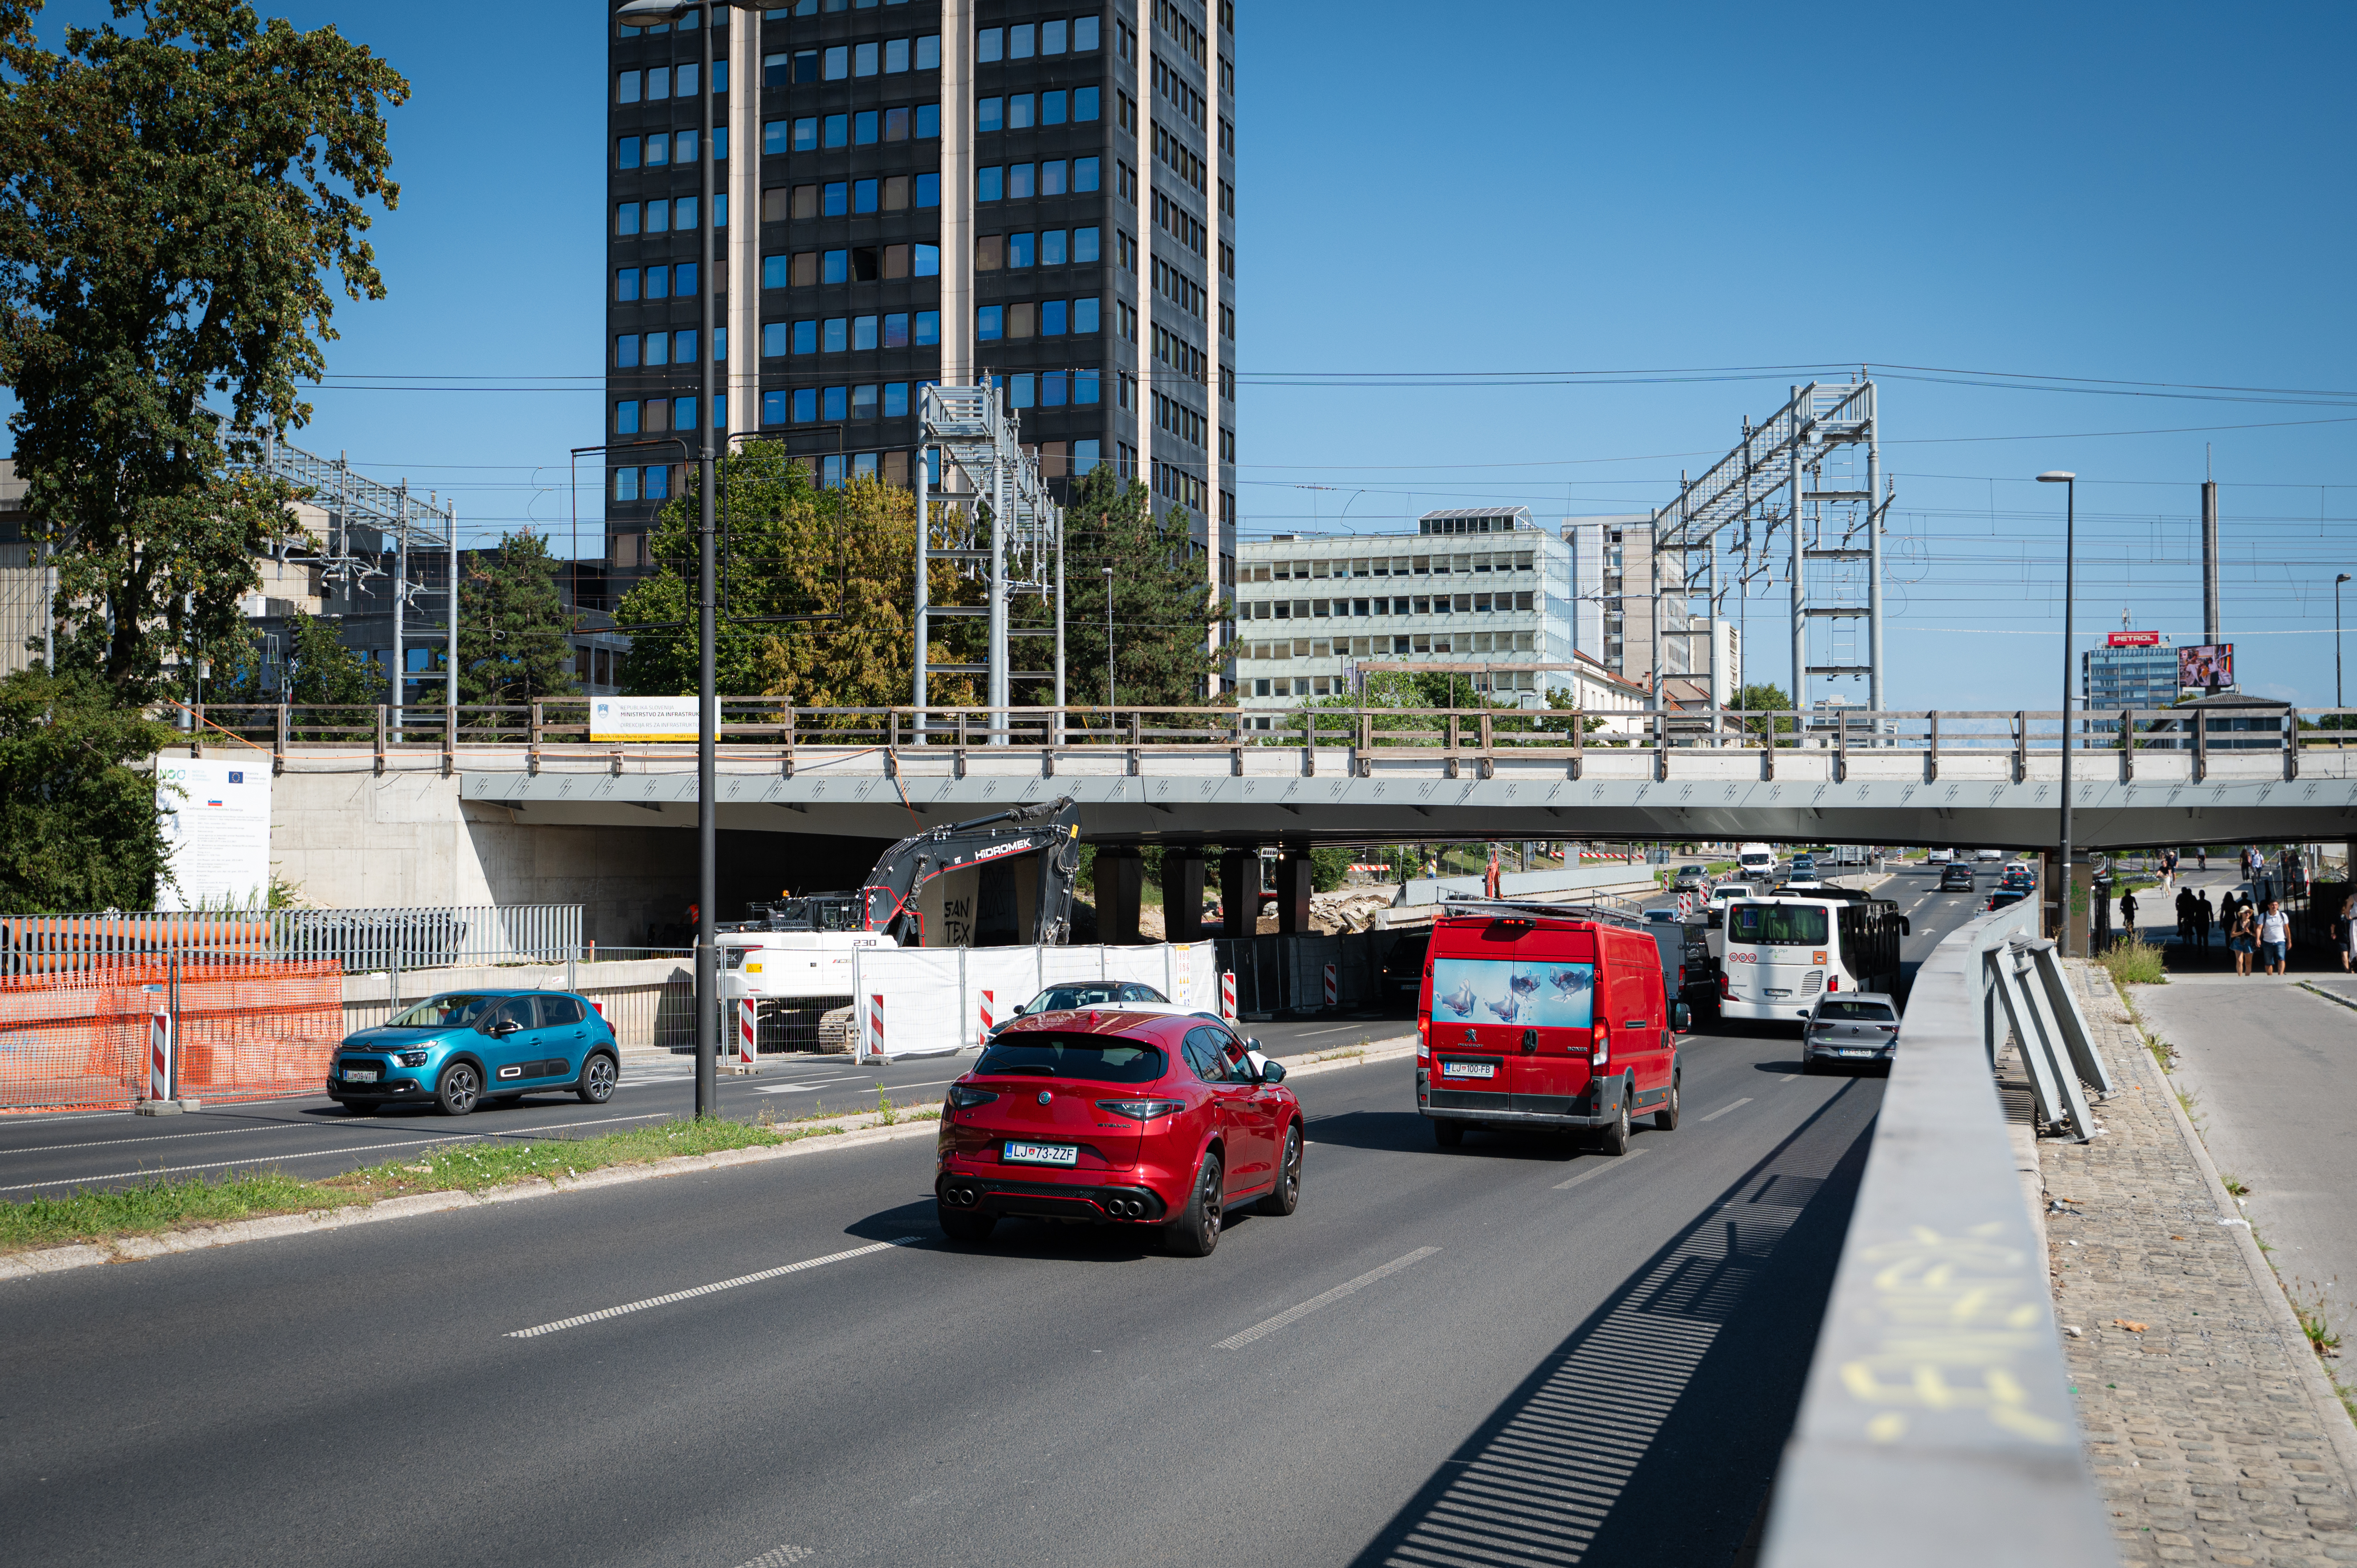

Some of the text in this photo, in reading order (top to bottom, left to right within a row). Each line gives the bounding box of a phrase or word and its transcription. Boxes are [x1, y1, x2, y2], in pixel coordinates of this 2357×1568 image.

[944, 896, 970, 918] SAN
[945, 920, 970, 944] TEX
[1452, 1064, 1490, 1073] LJ 100-FB
[1014, 1145, 1074, 1160] LJ 73-ZZF
